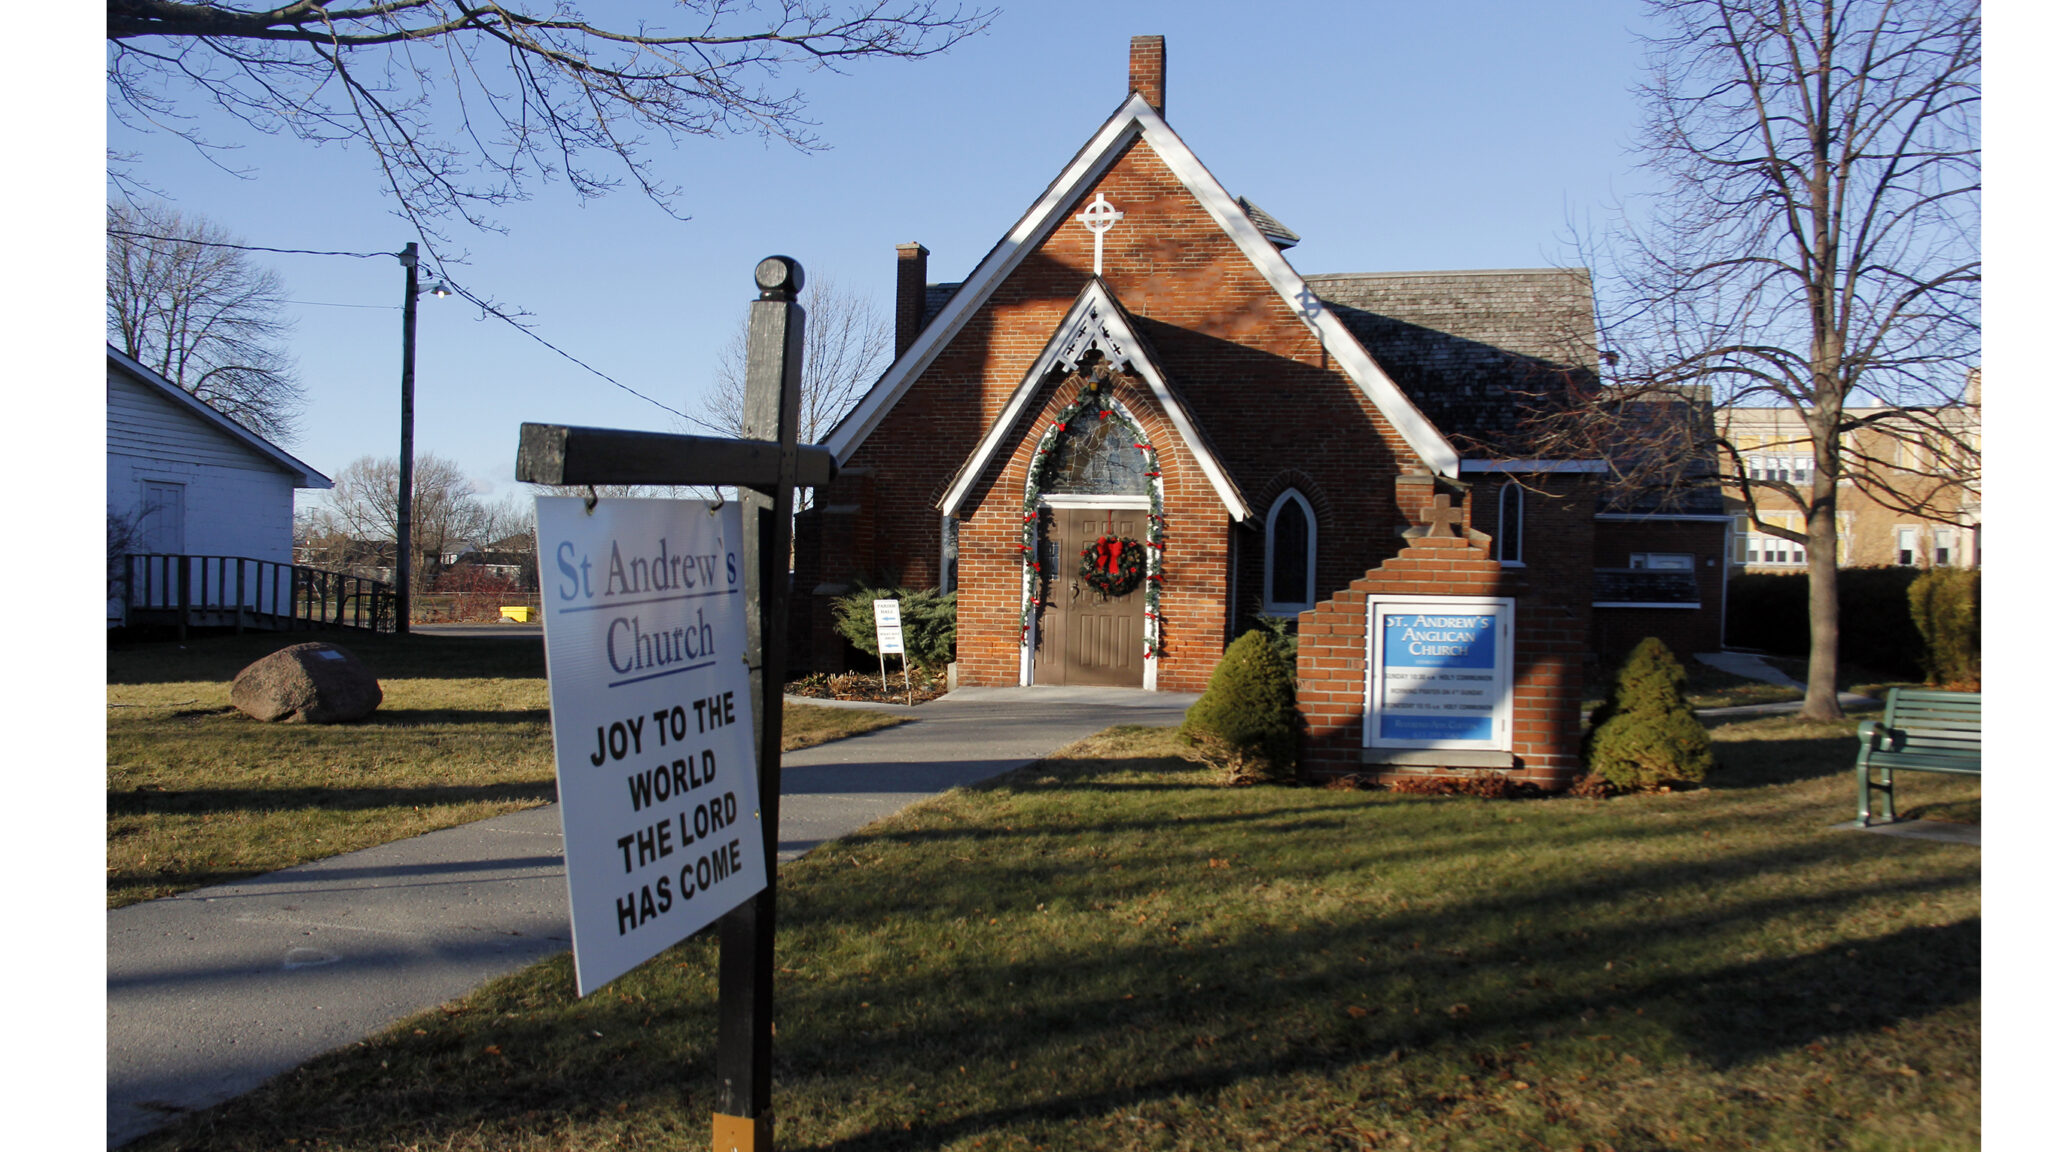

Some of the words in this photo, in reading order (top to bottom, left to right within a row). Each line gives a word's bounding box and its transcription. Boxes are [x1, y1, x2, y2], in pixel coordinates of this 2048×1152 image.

[556, 540, 594, 602] St
[607, 607, 715, 675] Church
[1401, 628, 1476, 642] ANGLICAN
[1408, 642, 1469, 656] CHURCH
[1413, 615, 1489, 629] ANDREW'S
[590, 715, 644, 768] JOY
[653, 705, 687, 747] TO
[692, 691, 736, 734] THE
[628, 749, 716, 812] WORLD
[617, 818, 673, 874] THE
[679, 791, 737, 848] LORD
[616, 876, 672, 936] HAS
[680, 838, 742, 901] COME
